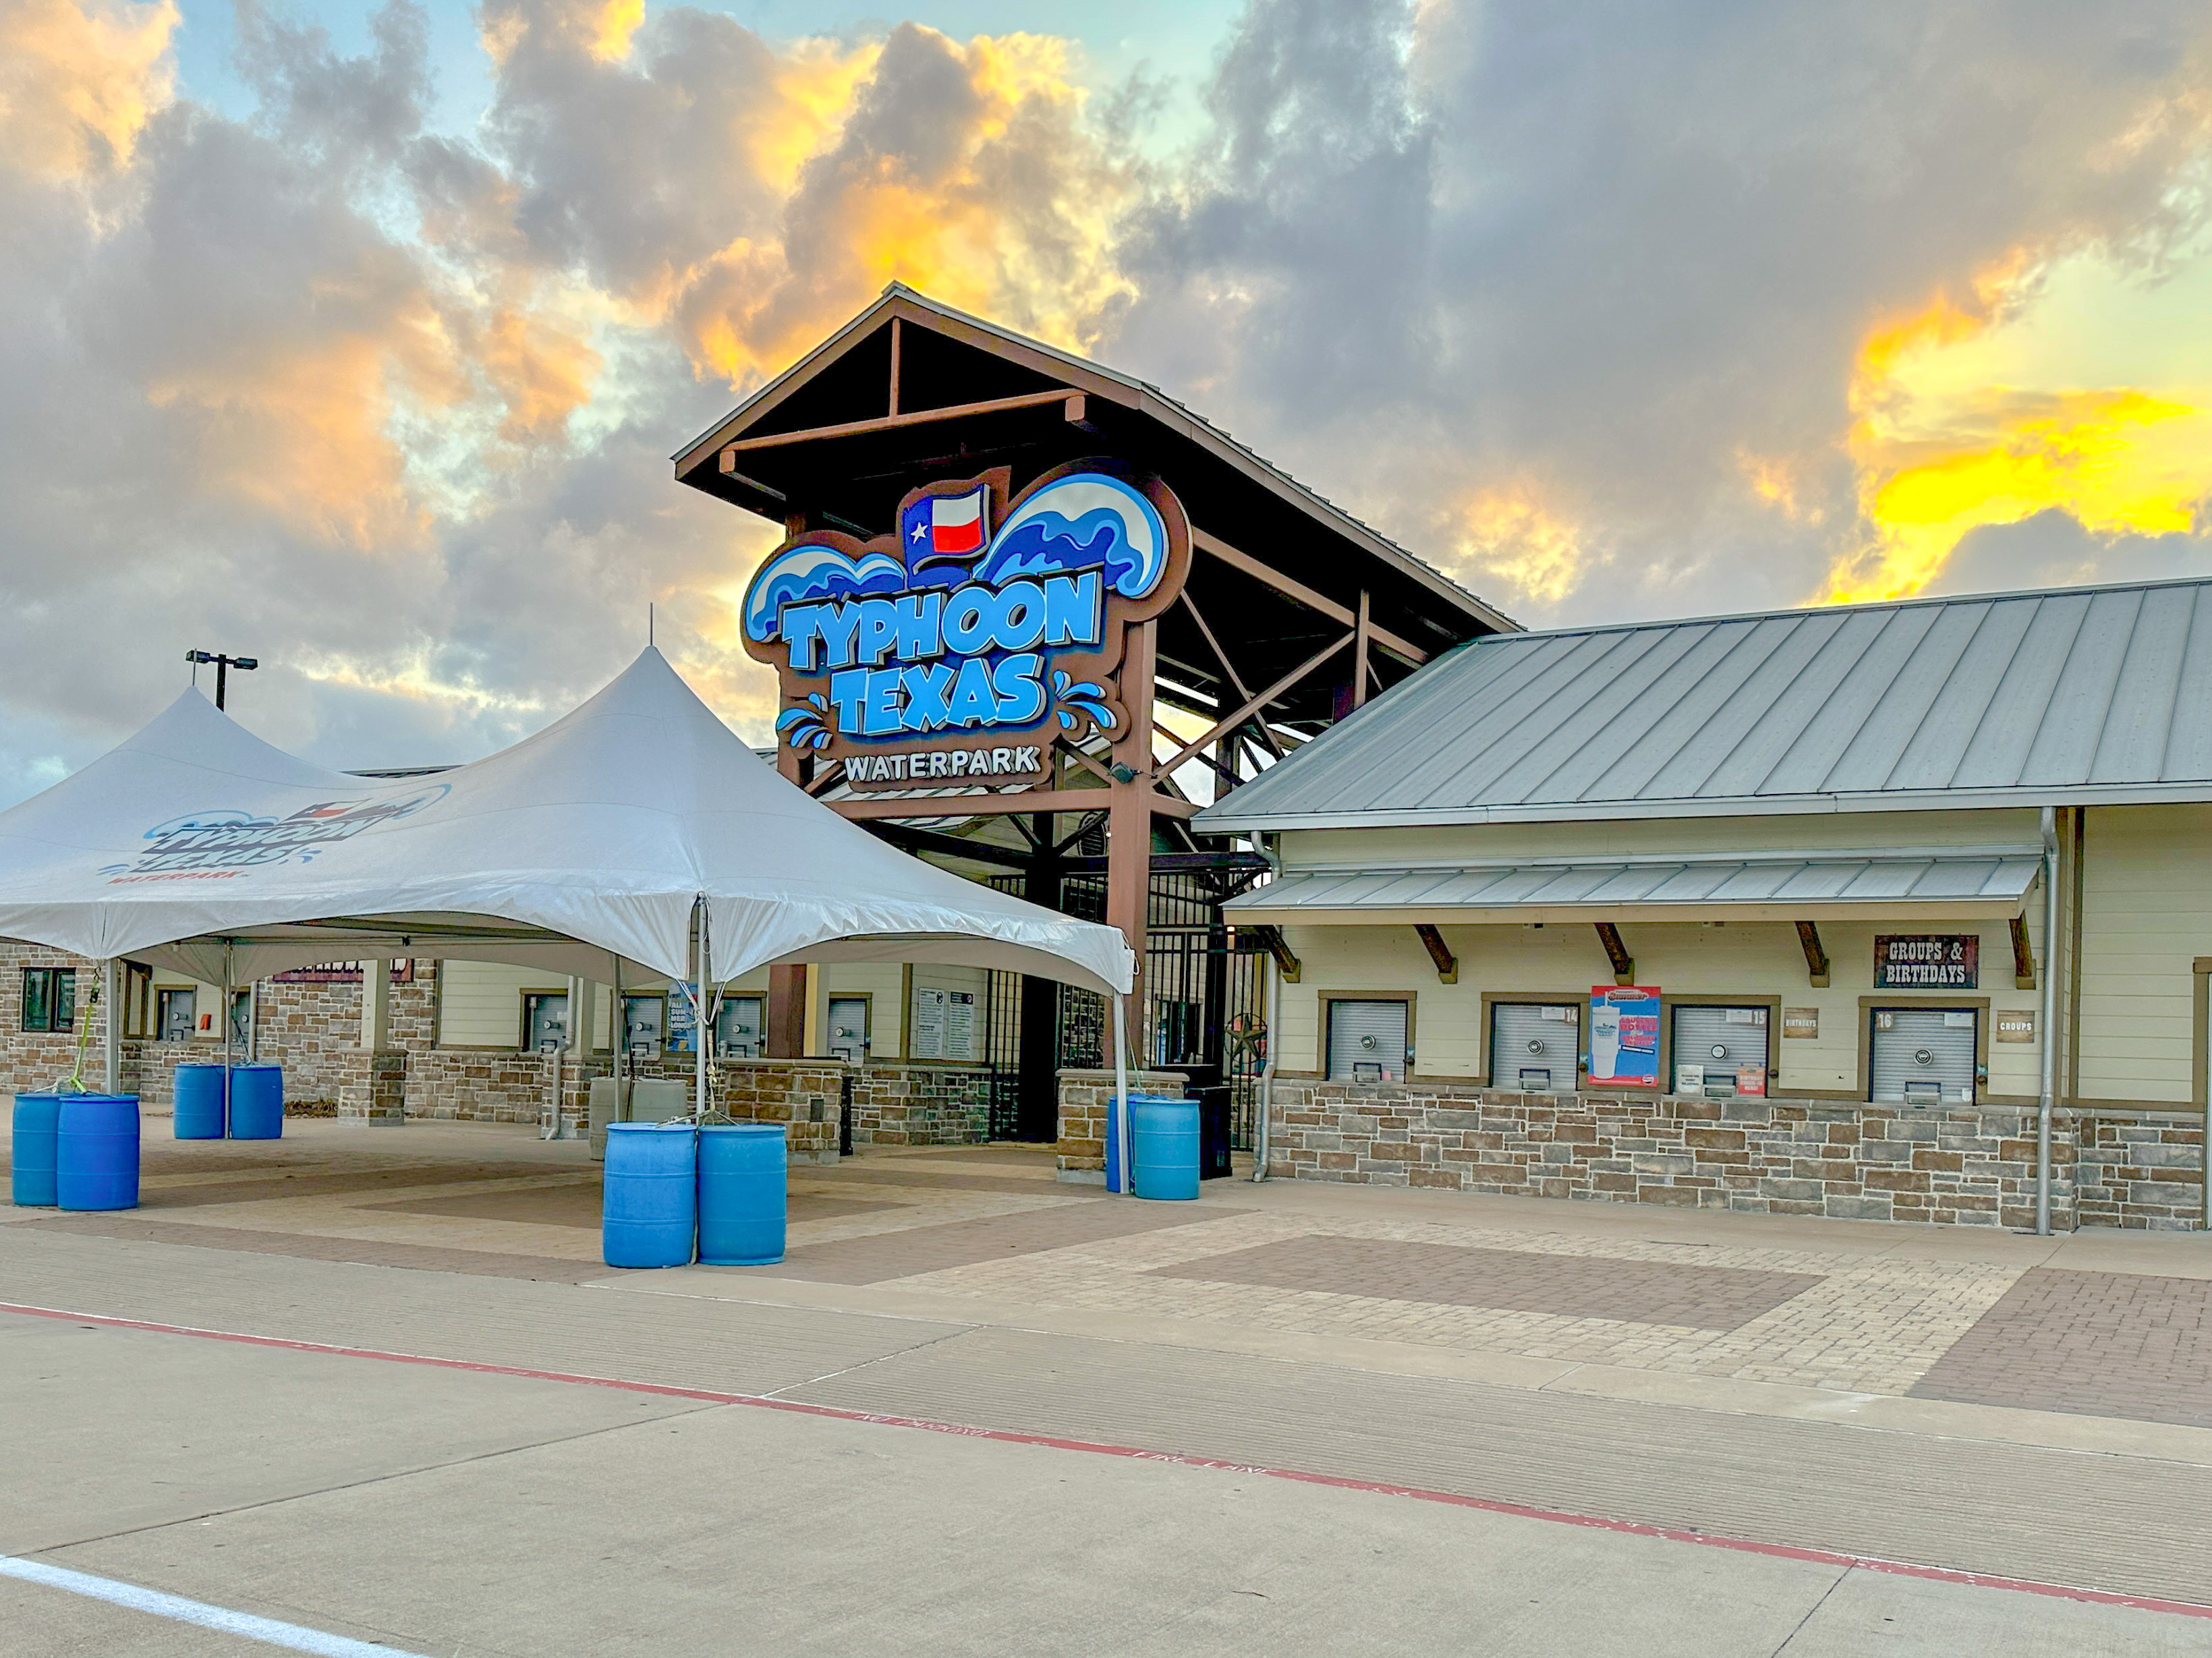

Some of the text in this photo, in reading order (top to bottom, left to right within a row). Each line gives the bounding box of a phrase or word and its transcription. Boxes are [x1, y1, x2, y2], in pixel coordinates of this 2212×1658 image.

[782, 569, 1102, 670] TYPHOON
[830, 652, 1045, 736] TEXAS
[845, 746, 1043, 782] WATERPARK
[151, 817, 382, 852] TYPHOON
[136, 845, 298, 871] TEXAS
[108, 871, 241, 884] WATERPARK
[1889, 942, 1964, 961] GROUPS &
[1885, 964, 1966, 983] BIRTHDAYS
[1566, 1009, 1578, 1022] 14
[1754, 1010, 1765, 1025] 15
[1785, 1019, 1817, 1027] BIRTHDAYS
[1878, 1013, 1892, 1028] 16
[2000, 1022, 2032, 1031] GROUPS
[1132, 1451, 1185, 1464] FIRE
